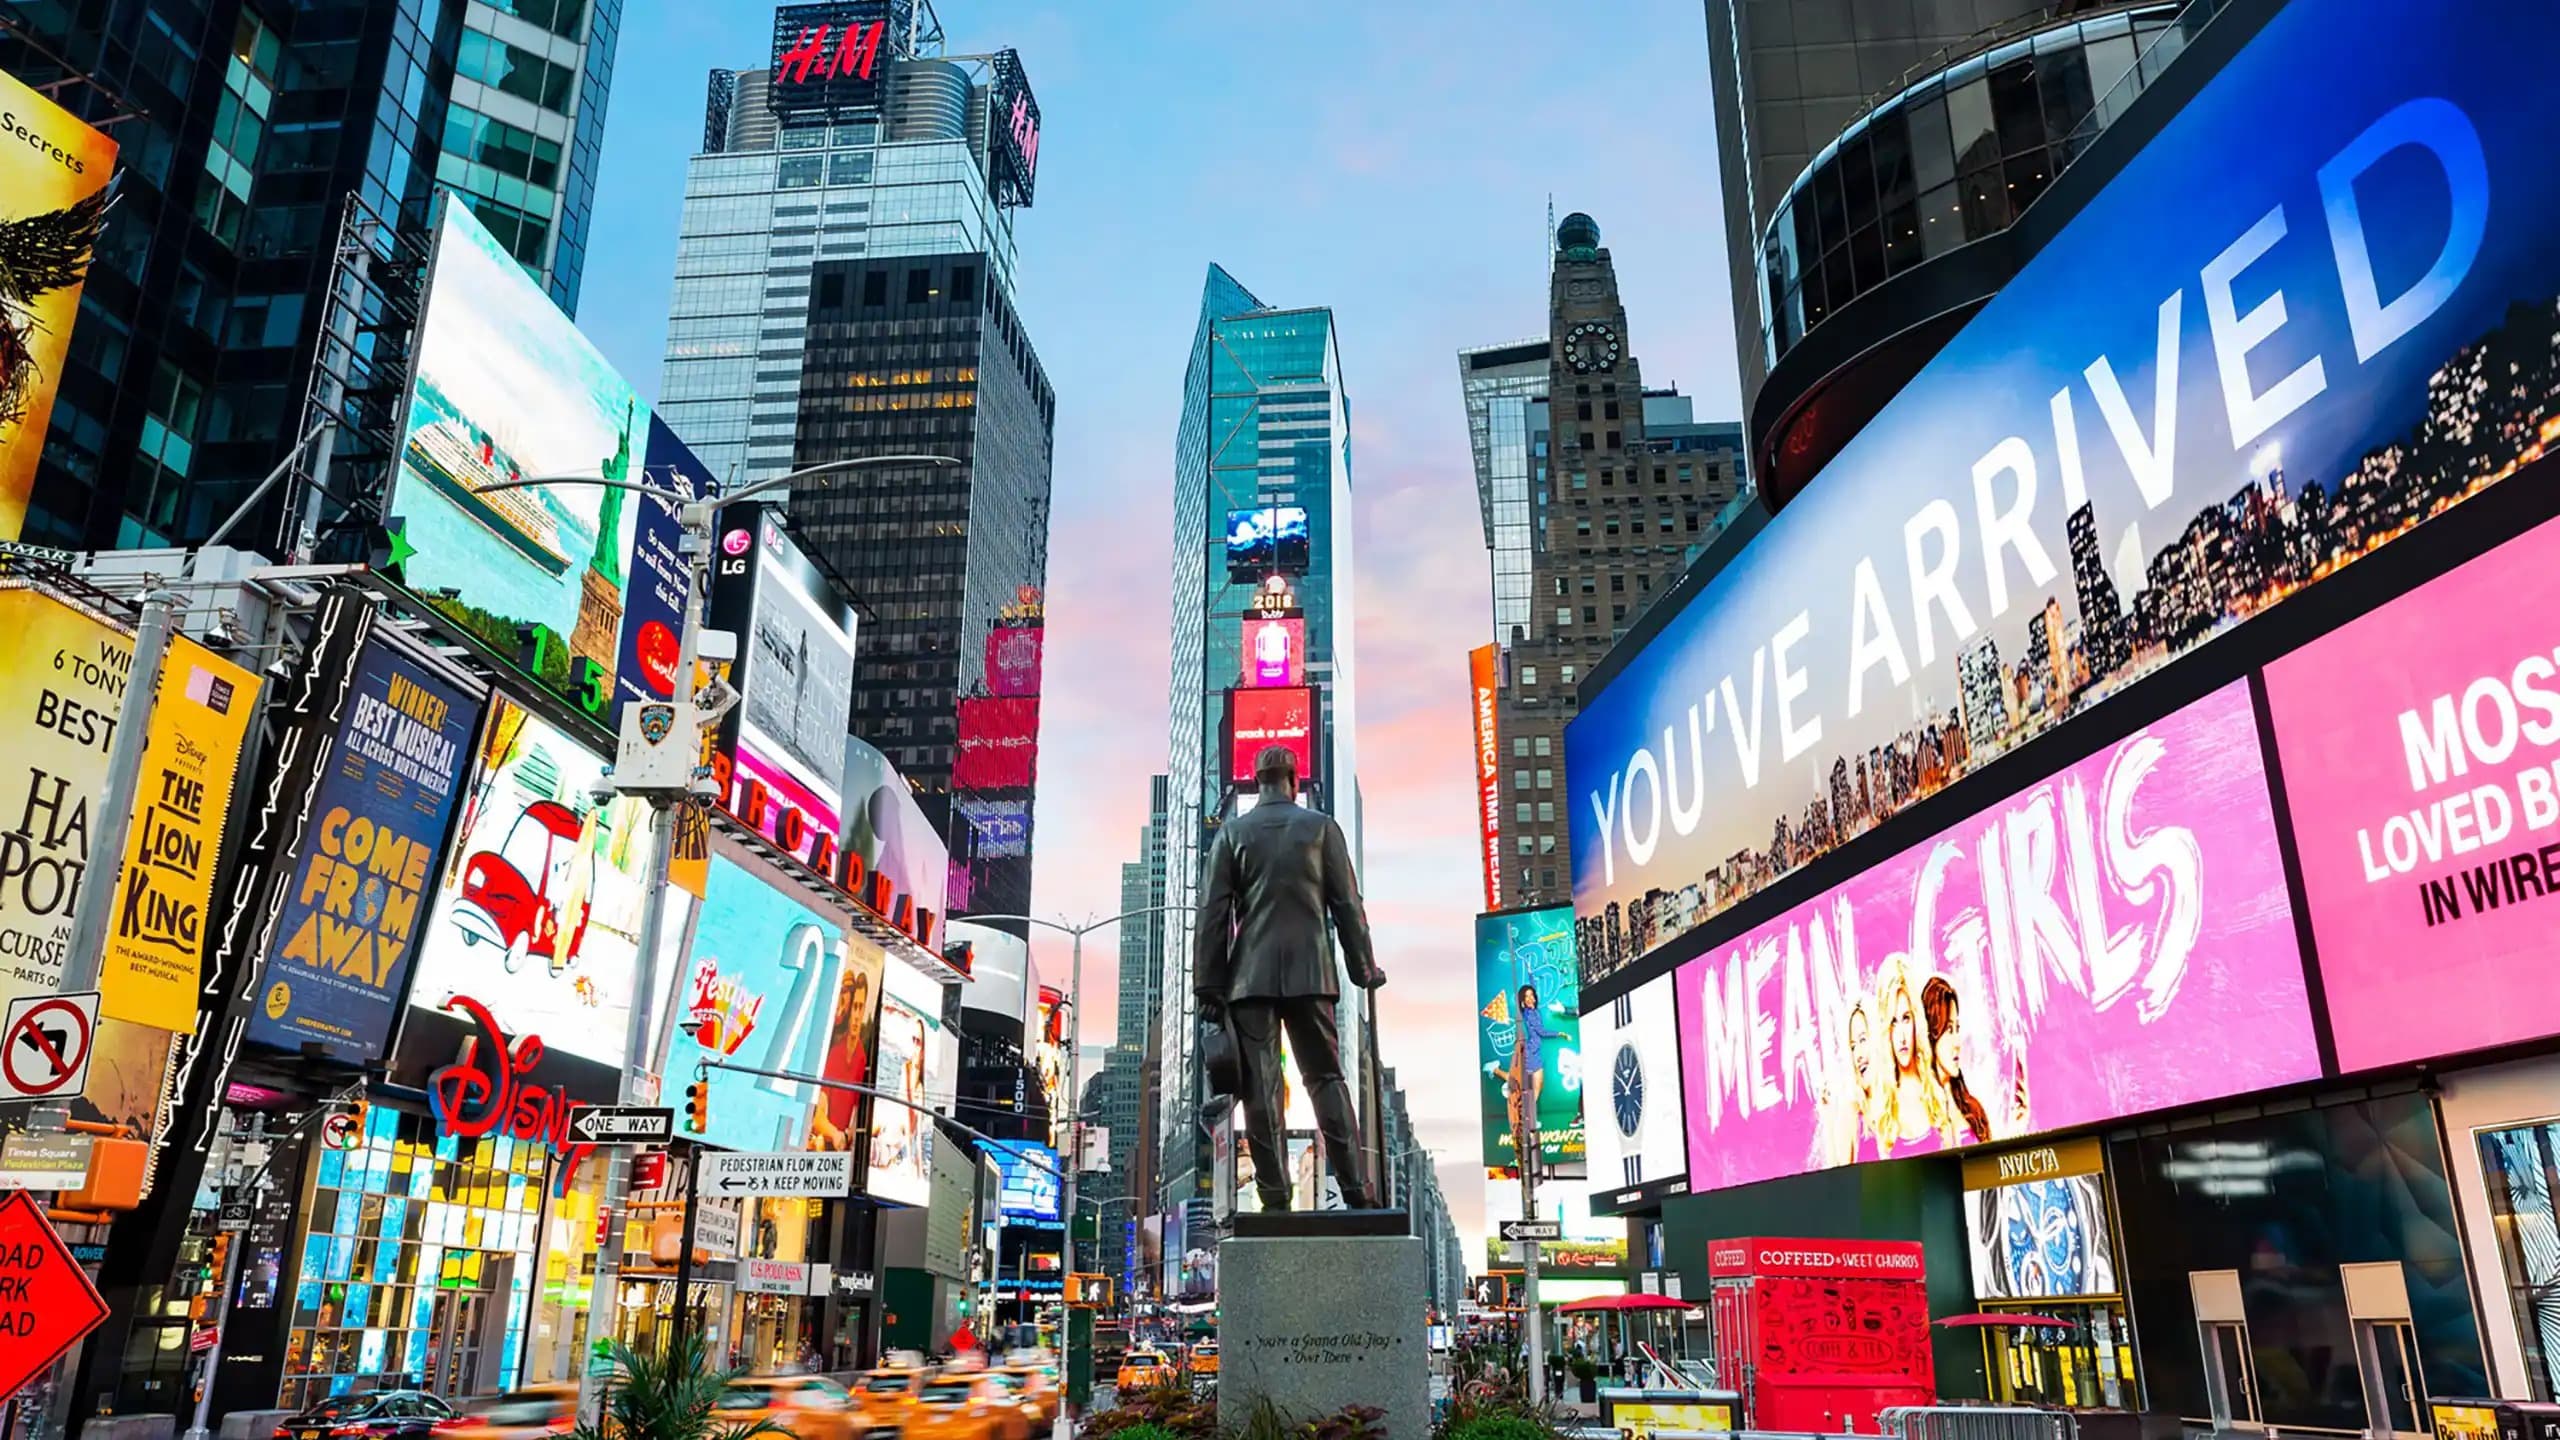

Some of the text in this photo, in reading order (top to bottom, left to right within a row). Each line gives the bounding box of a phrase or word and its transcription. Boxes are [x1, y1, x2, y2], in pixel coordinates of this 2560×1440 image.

[777, 21, 885, 84] H&M
[1, 111, 85, 176] Secrets
[1590, 97, 2490, 887] YOU'VE ARRIVED
[721, 560, 745, 575] LG
[1254, 595, 1293, 609] 2018
[54, 649, 64, 670] 6
[35, 688, 117, 753] BEST
[388, 672, 449, 732] WINNER!
[2398, 646, 2560, 792] MOS
[352, 693, 397, 743] BEST
[393, 713, 457, 778] MUSICAL
[162, 769, 204, 815] THE
[1478, 687, 1501, 907] AMERICA TIME MEDIA
[139, 806, 202, 870] LION
[320, 807, 431, 892] COME
[712, 750, 936, 946] BROADWAY
[2357, 783, 2513, 884] LOVED
[120, 867, 198, 942] KING
[2420, 875, 2461, 927] IN
[281, 910, 405, 988] AWAY
[1702, 727, 2203, 1130] MEAN GIRLS
[13, 967, 45, 984] PARTS
[1014, 1068, 1024, 1113] 1500
[585, 1118, 660, 1132] ONE WAY
[8, 1147, 77, 1160] Times Square
[720, 1158, 844, 1172] PEDESTRIAN FLOW ZONE
[1999, 1147, 2058, 1179] INVICTA
[774, 1176, 843, 1190] KEEP MOVING
[1509, 1226, 1552, 1235] ONE WAY
[1759, 1250, 1834, 1267] COFFEED
[1842, 1253, 1872, 1267] SWEET
[1875, 1254, 1920, 1269] CHURROS
[1291, 1338, 1298, 1347] a
[1302, 1334, 1337, 1351] Grand
[1342, 1334, 1362, 1347] Old
[1295, 1352, 1352, 1364] Over There
